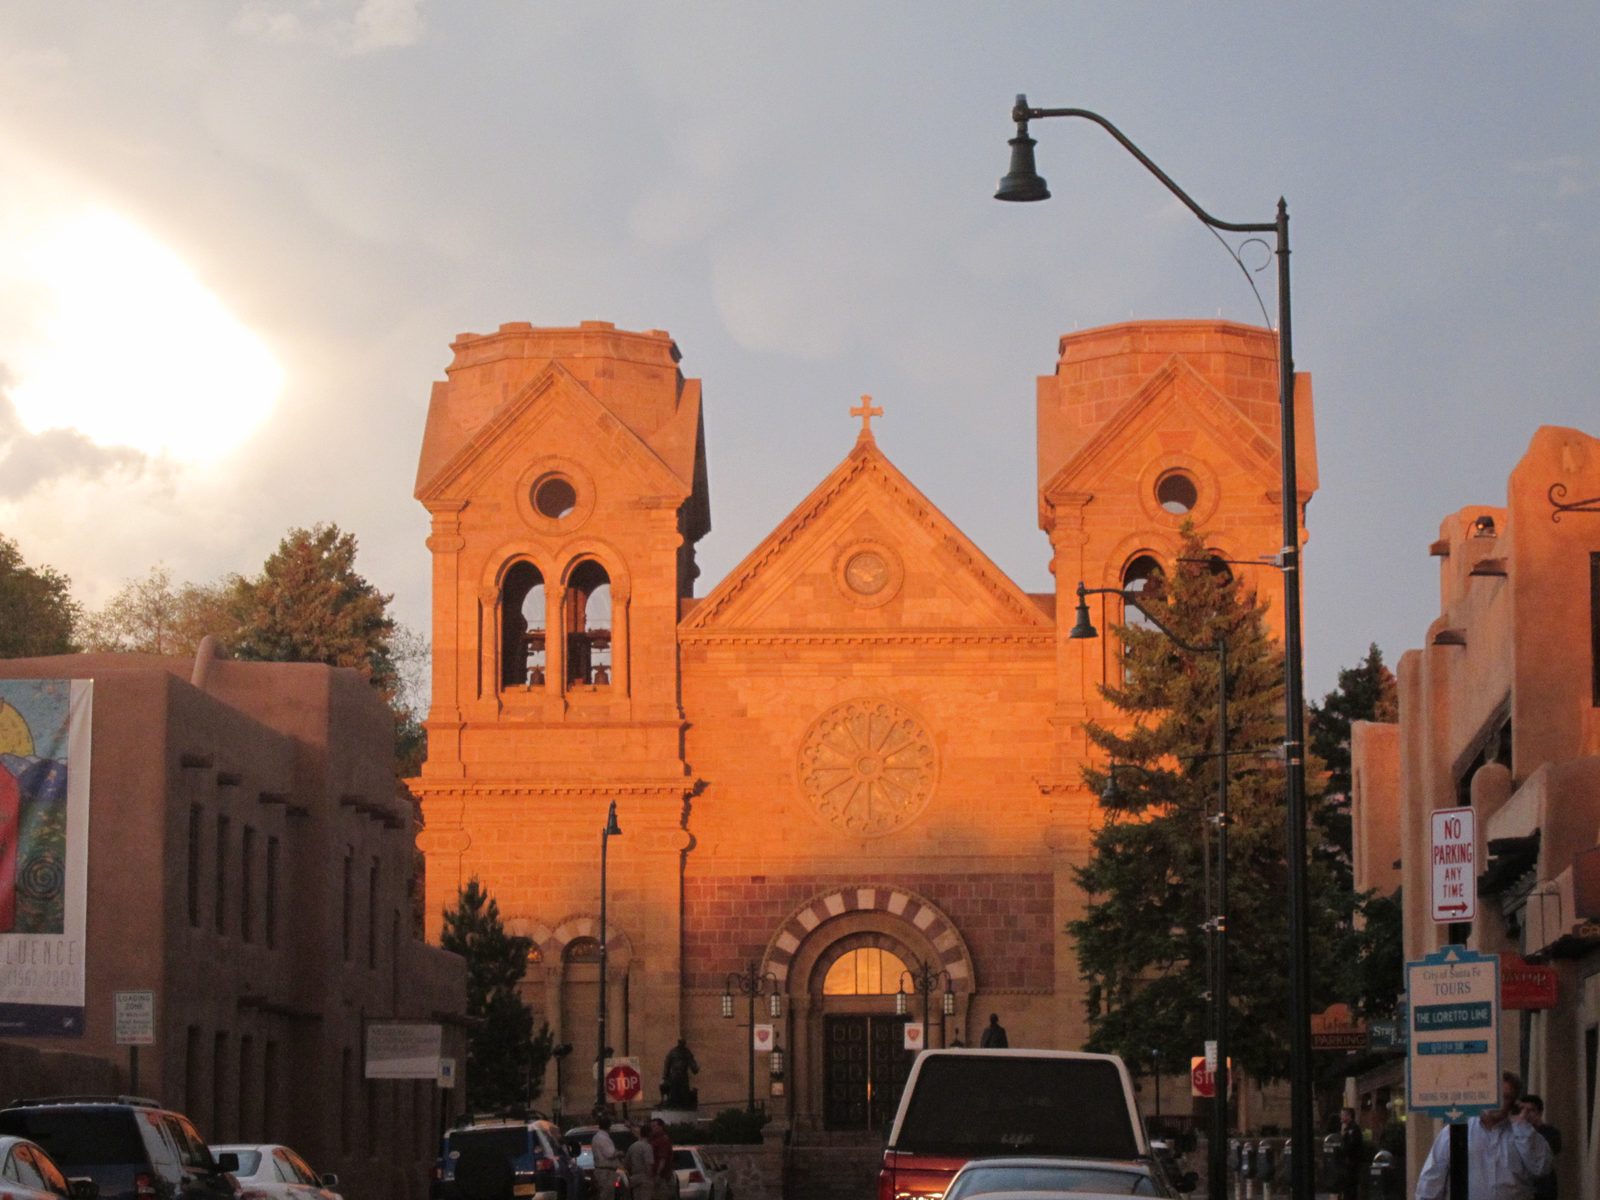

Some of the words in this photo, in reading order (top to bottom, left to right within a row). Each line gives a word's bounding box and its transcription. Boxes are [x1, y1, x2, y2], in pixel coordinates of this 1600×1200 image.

[1444, 818, 1461, 840] NO
[1433, 843, 1473, 865] PARKING
[1444, 866, 1462, 881] ANY
[1443, 883, 1464, 898] TIME
[1449, 968, 1471, 979] Santa
[1472, 966, 1481, 977] Fe
[1433, 980, 1472, 996] TOURS
[1416, 1012, 1430, 1024] THE
[1432, 1010, 1469, 1023] LORETTO
[1471, 1008, 1489, 1021] LINE
[1313, 1034, 1366, 1047] PARKING
[607, 1075, 639, 1092] STOP
[1194, 1070, 1215, 1085] ST
